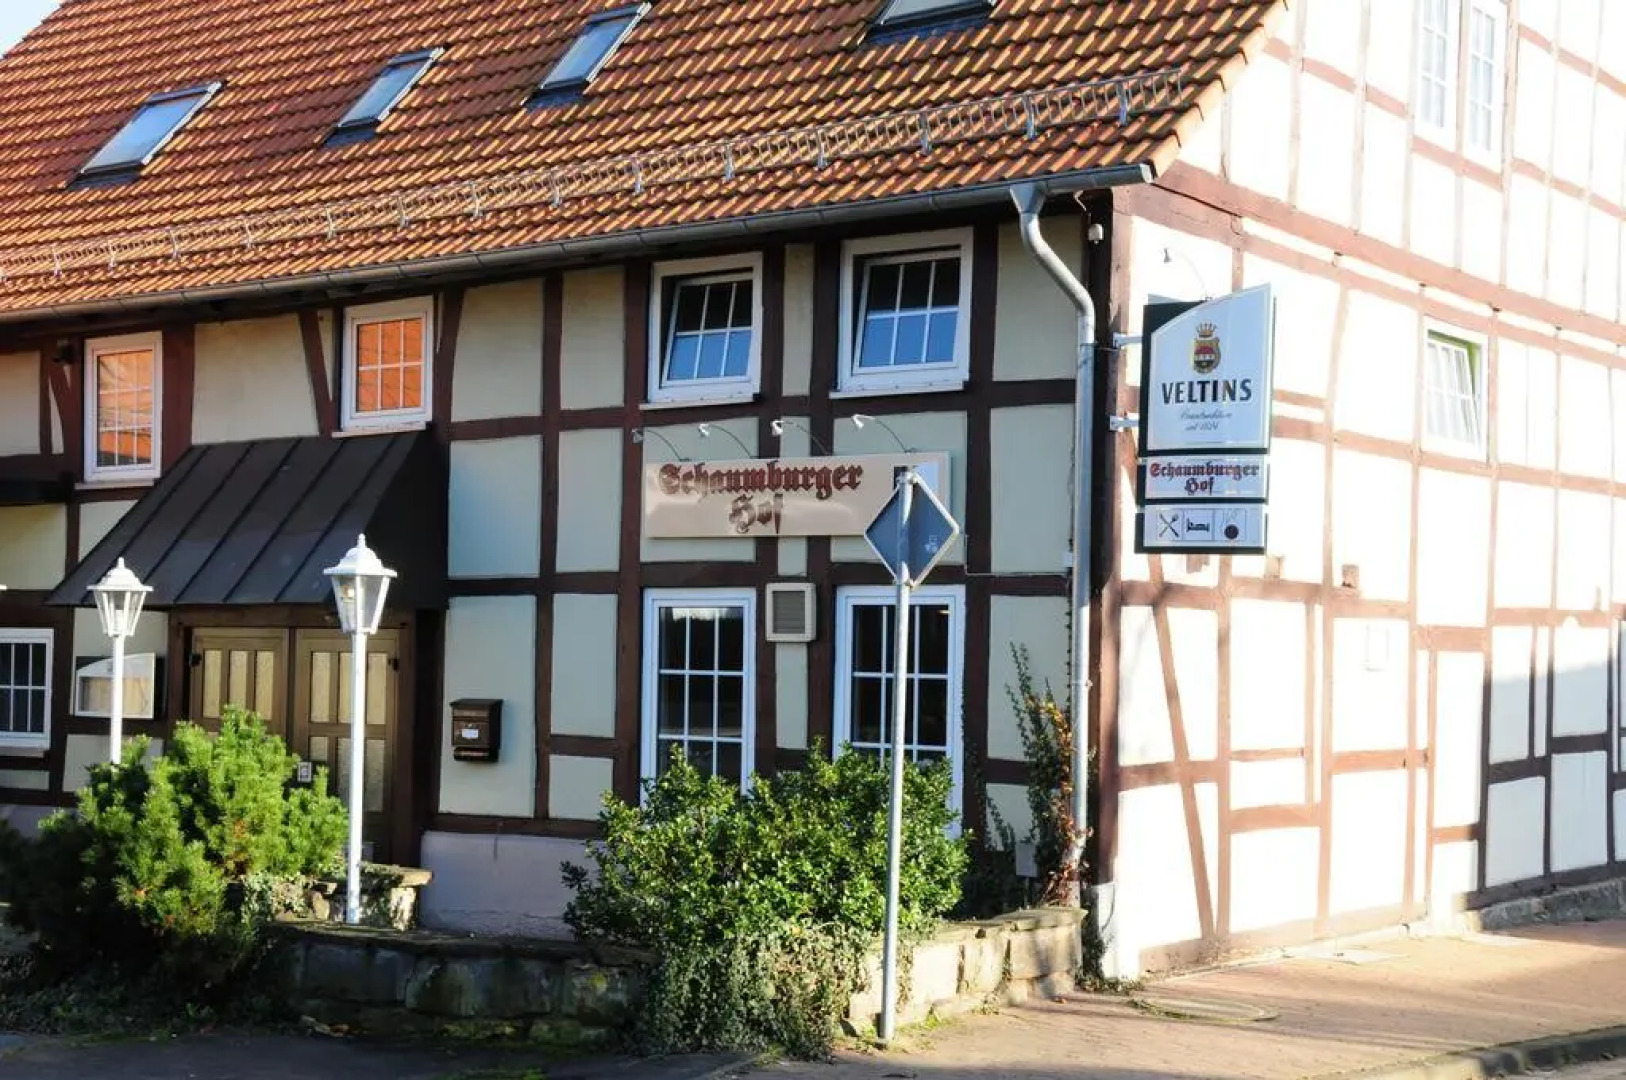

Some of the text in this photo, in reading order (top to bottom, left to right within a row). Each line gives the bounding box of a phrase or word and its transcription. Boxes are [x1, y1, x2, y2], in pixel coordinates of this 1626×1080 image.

[1162, 378, 1252, 405] VELTINS
[659, 460, 863, 501] Schaumburger
[1150, 461, 1259, 481] Schaumburger
[1184, 476, 1215, 496] Hof
[728, 493, 783, 534] Hof
